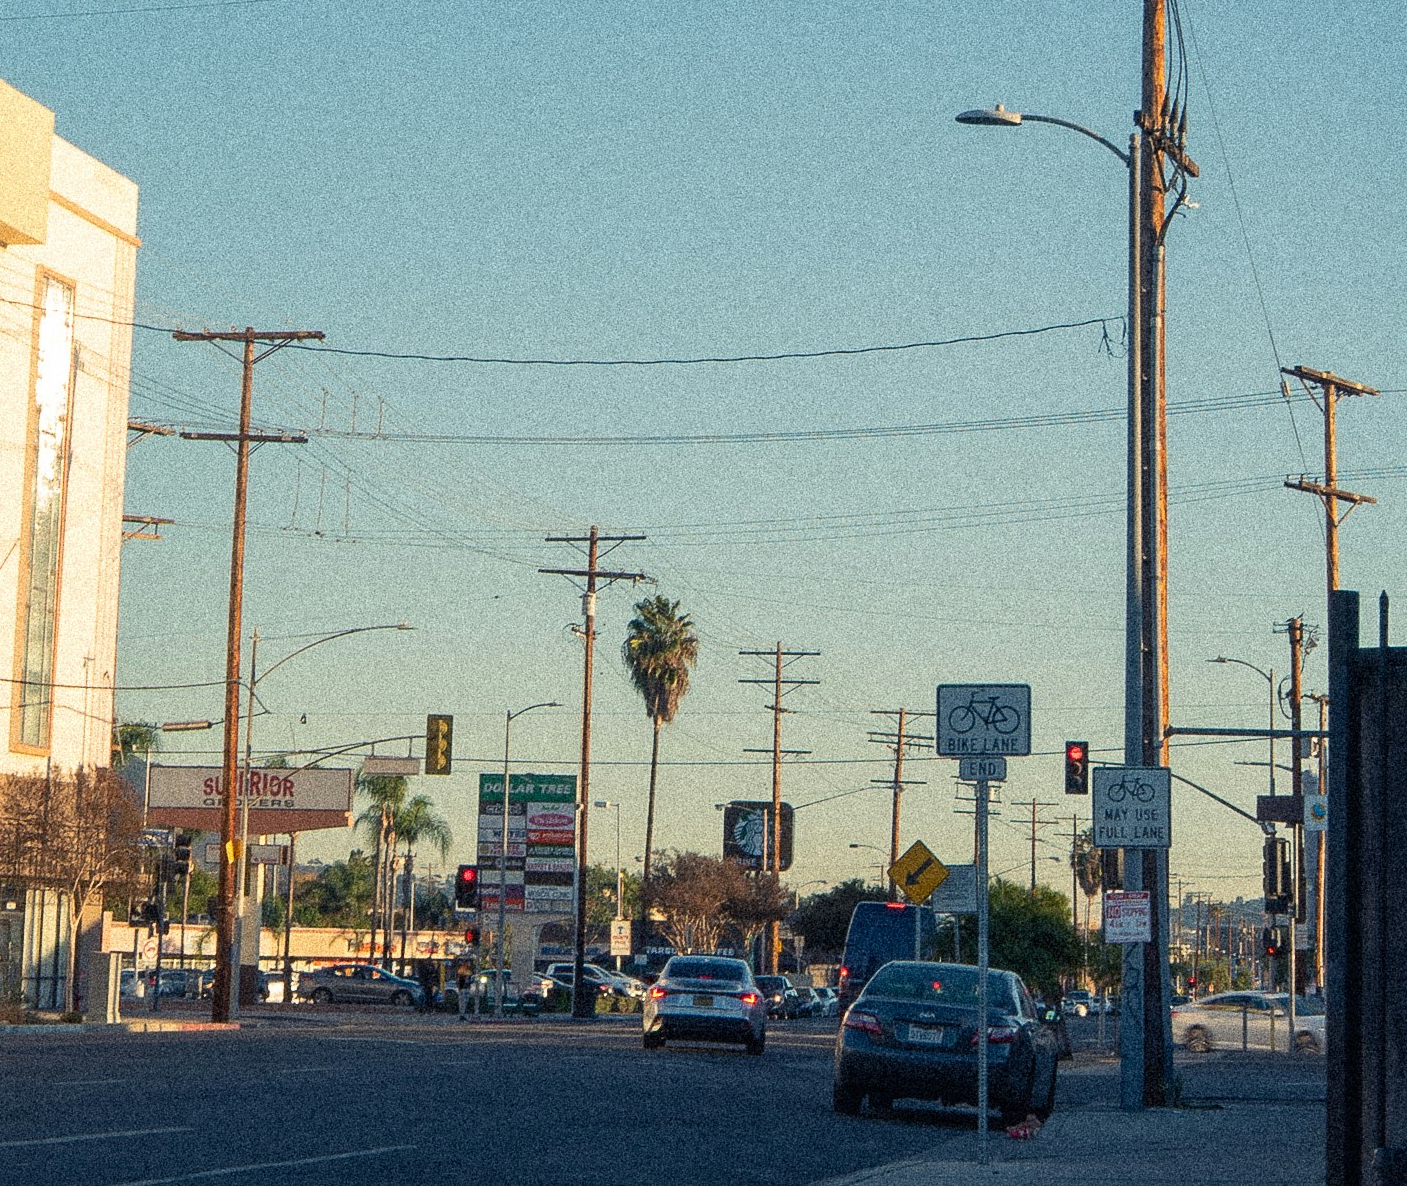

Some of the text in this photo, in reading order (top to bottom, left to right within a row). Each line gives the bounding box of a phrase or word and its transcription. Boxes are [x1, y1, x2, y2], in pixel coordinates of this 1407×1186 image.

[948, 737, 1019, 752] BIKE LANE
[969, 762, 997, 776] END
[203, 770, 295, 798] SURIOR
[539, 783, 572, 795] TREE
[1104, 808, 1158, 821] MAY USE
[1099, 826, 1164, 839] FULL LANE
